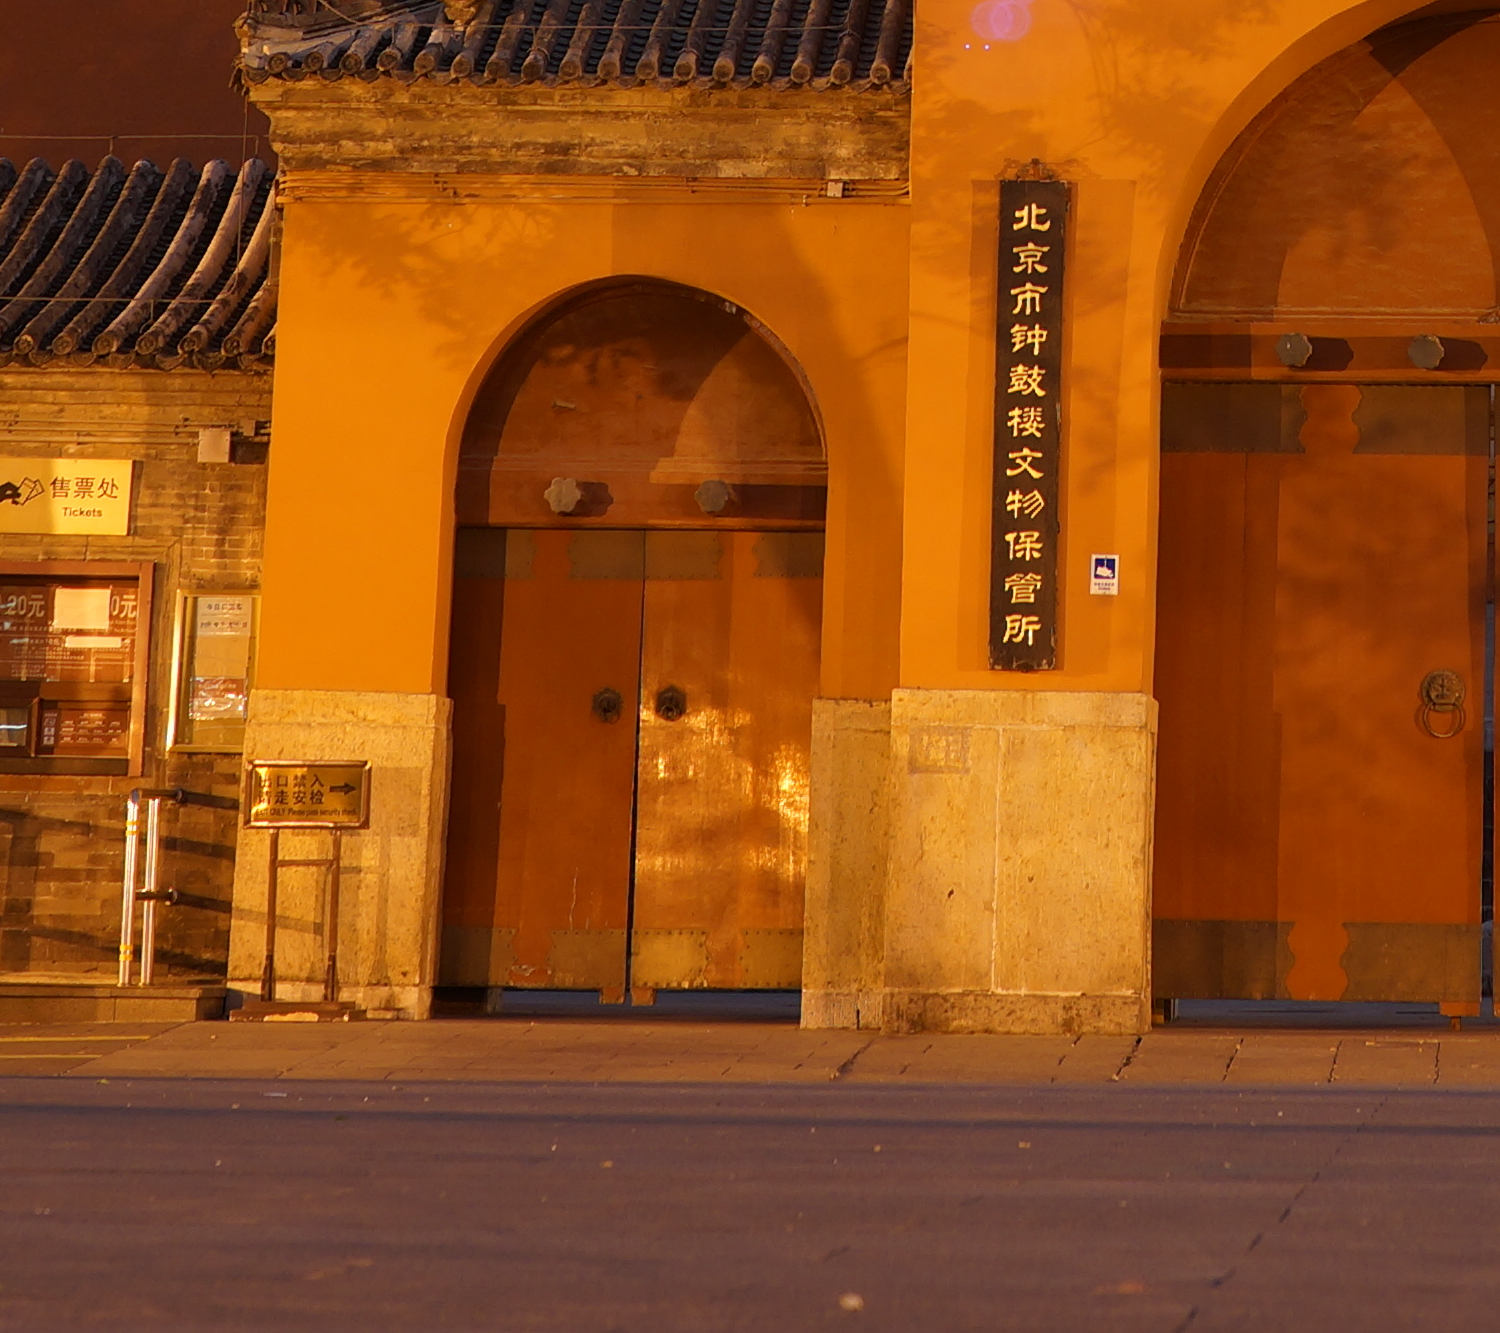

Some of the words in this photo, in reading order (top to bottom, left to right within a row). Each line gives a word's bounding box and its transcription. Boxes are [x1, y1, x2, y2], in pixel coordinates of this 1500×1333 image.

[1002, 202, 1051, 648] 北京市钟鼓楼文物保管所
[49, 476, 120, 500] 售票处
[62, 506, 103, 518] Tickets
[258, 773, 325, 789] 出口禁入
